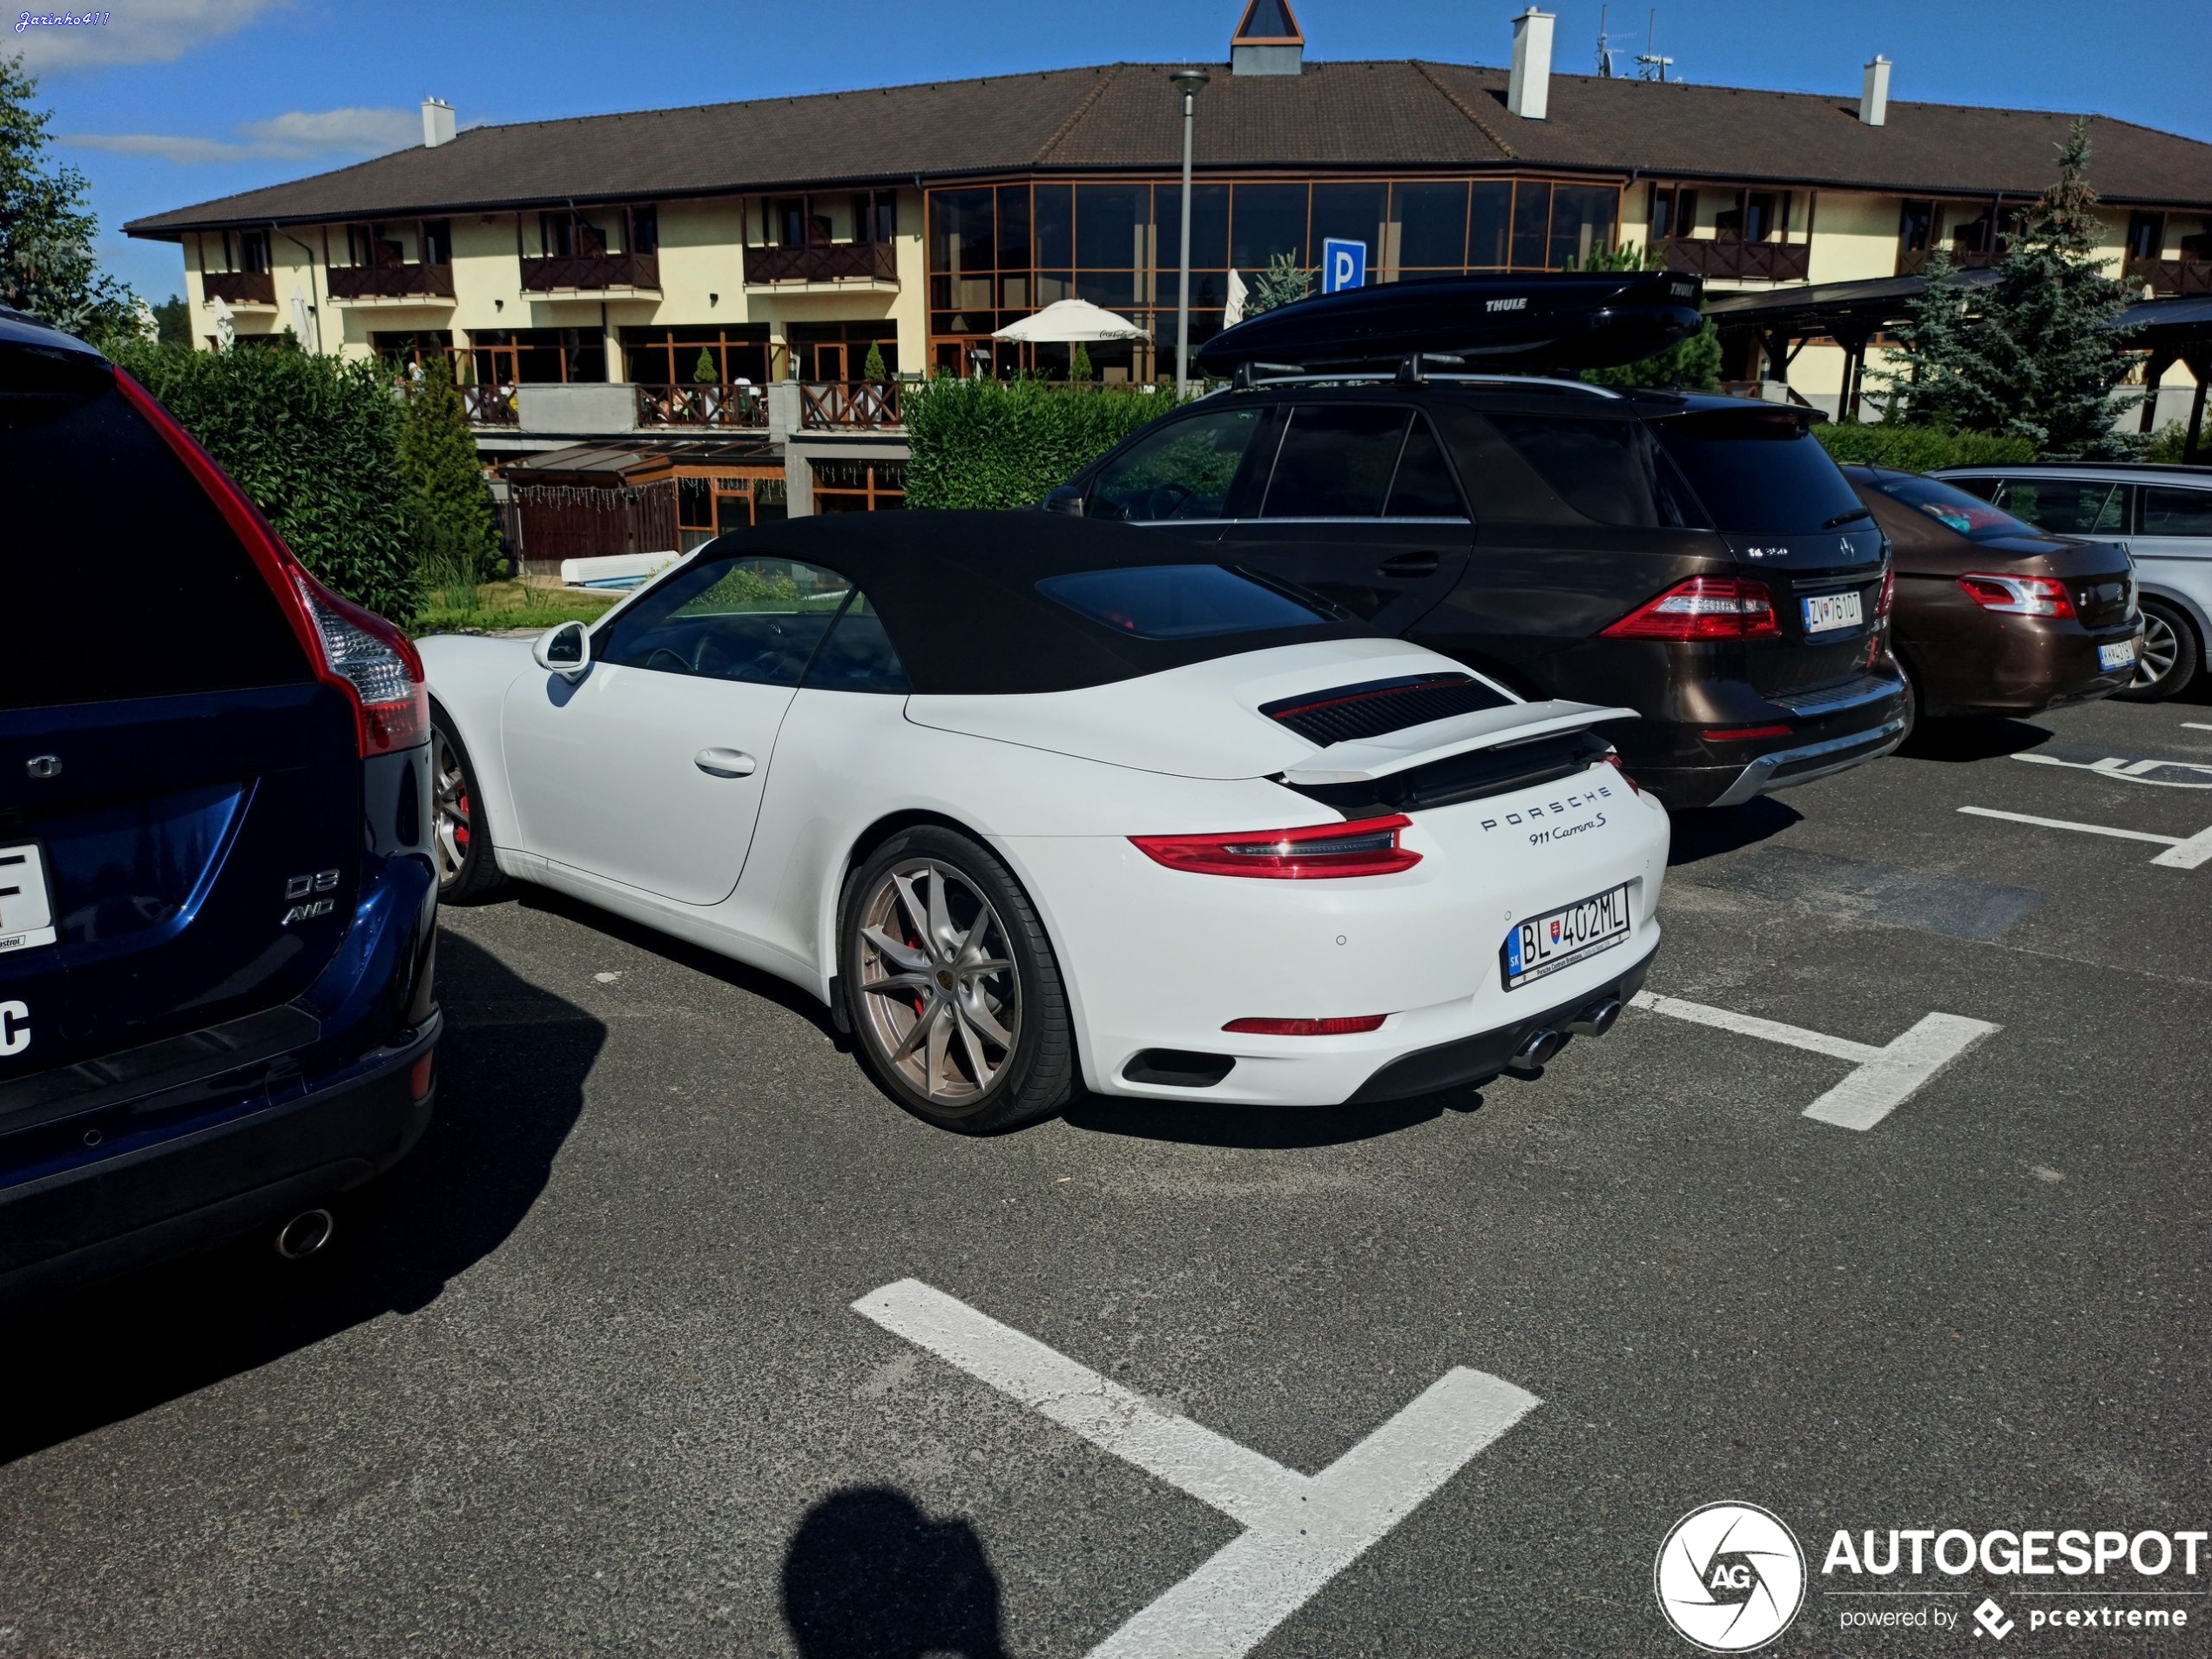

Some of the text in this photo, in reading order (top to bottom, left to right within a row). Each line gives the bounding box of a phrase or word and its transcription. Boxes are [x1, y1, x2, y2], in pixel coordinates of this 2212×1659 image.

[1335, 251, 1354, 292] P
[1486, 297, 1527, 312] THULE
[1670, 282, 1695, 298] THULE
[1480, 786, 1612, 832] PORSCHE
[1529, 813, 1607, 846] 911 Carrera S
[281, 898, 335, 926] AWD
[1522, 892, 1624, 965] BL 402ML
[1510, 954, 1520, 968] SK
